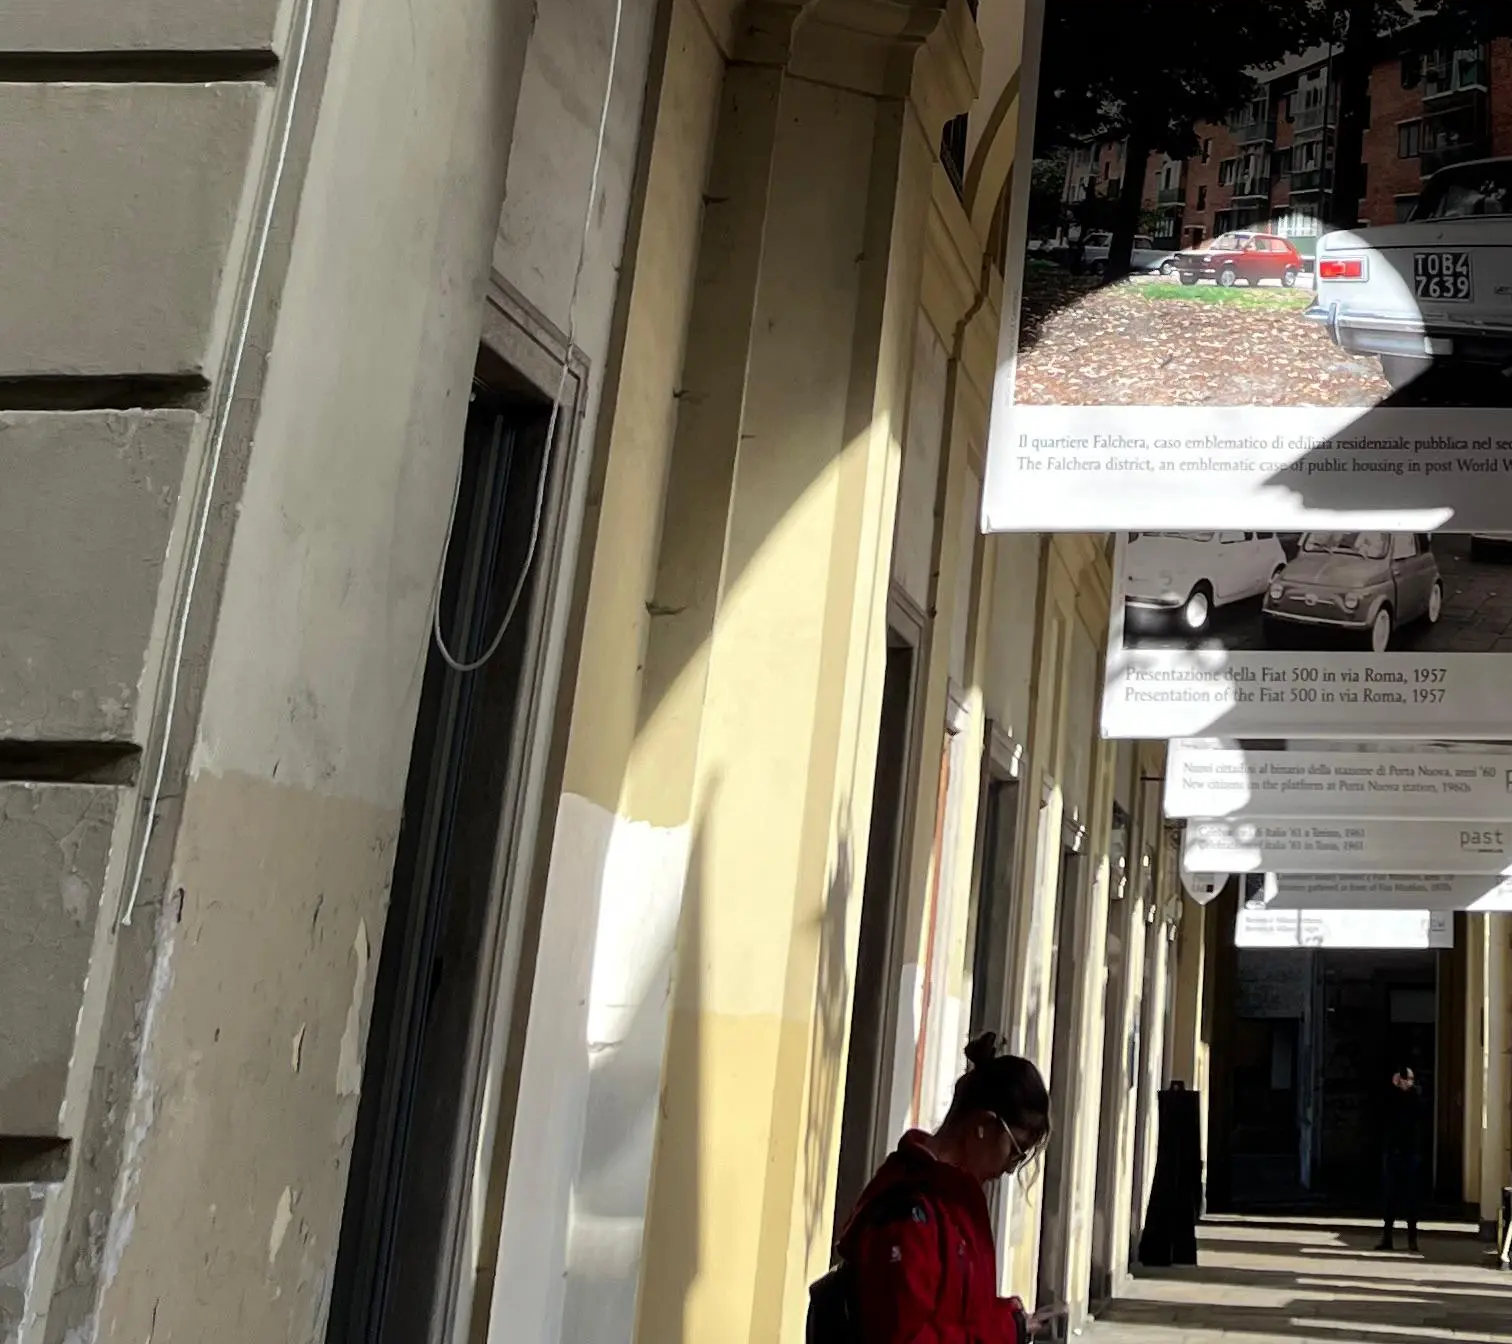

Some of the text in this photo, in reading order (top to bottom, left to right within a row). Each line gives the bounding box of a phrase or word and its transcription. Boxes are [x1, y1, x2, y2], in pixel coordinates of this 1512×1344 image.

[1416, 276, 1469, 298] 7639
[1031, 434, 1089, 452] quartiere
[1092, 434, 1150, 450] Falchera,
[1153, 438, 1182, 449] caso
[1184, 434, 1268, 449] emblematico
[1271, 434, 1285, 449] di
[1288, 434, 1333, 450] edilizia
[1335, 434, 1411, 450] residenziale
[1414, 436, 1468, 453] pubblica
[1472, 436, 1492, 450] nel
[1017, 456, 1043, 470] The
[1046, 457, 1101, 471] Falchera
[1105, 457, 1155, 472] district,
[1158, 461, 1175, 471] an
[1179, 457, 1255, 471] emblematic
[1259, 462, 1287, 471] case
[1290, 457, 1304, 472] of
[1308, 457, 1348, 476] public
[1352, 457, 1405, 476] housing
[1408, 459, 1421, 472] in
[1425, 460, 1453, 476] post
[1455, 458, 1498, 472] World
[1125, 667, 1447, 684] Presentazione della Fiat 500 in via Roma, 1957
[1124, 687, 1446, 704] Presentation of the Fiat 500 in via Roma, 1957
[1460, 828, 1504, 848] past
